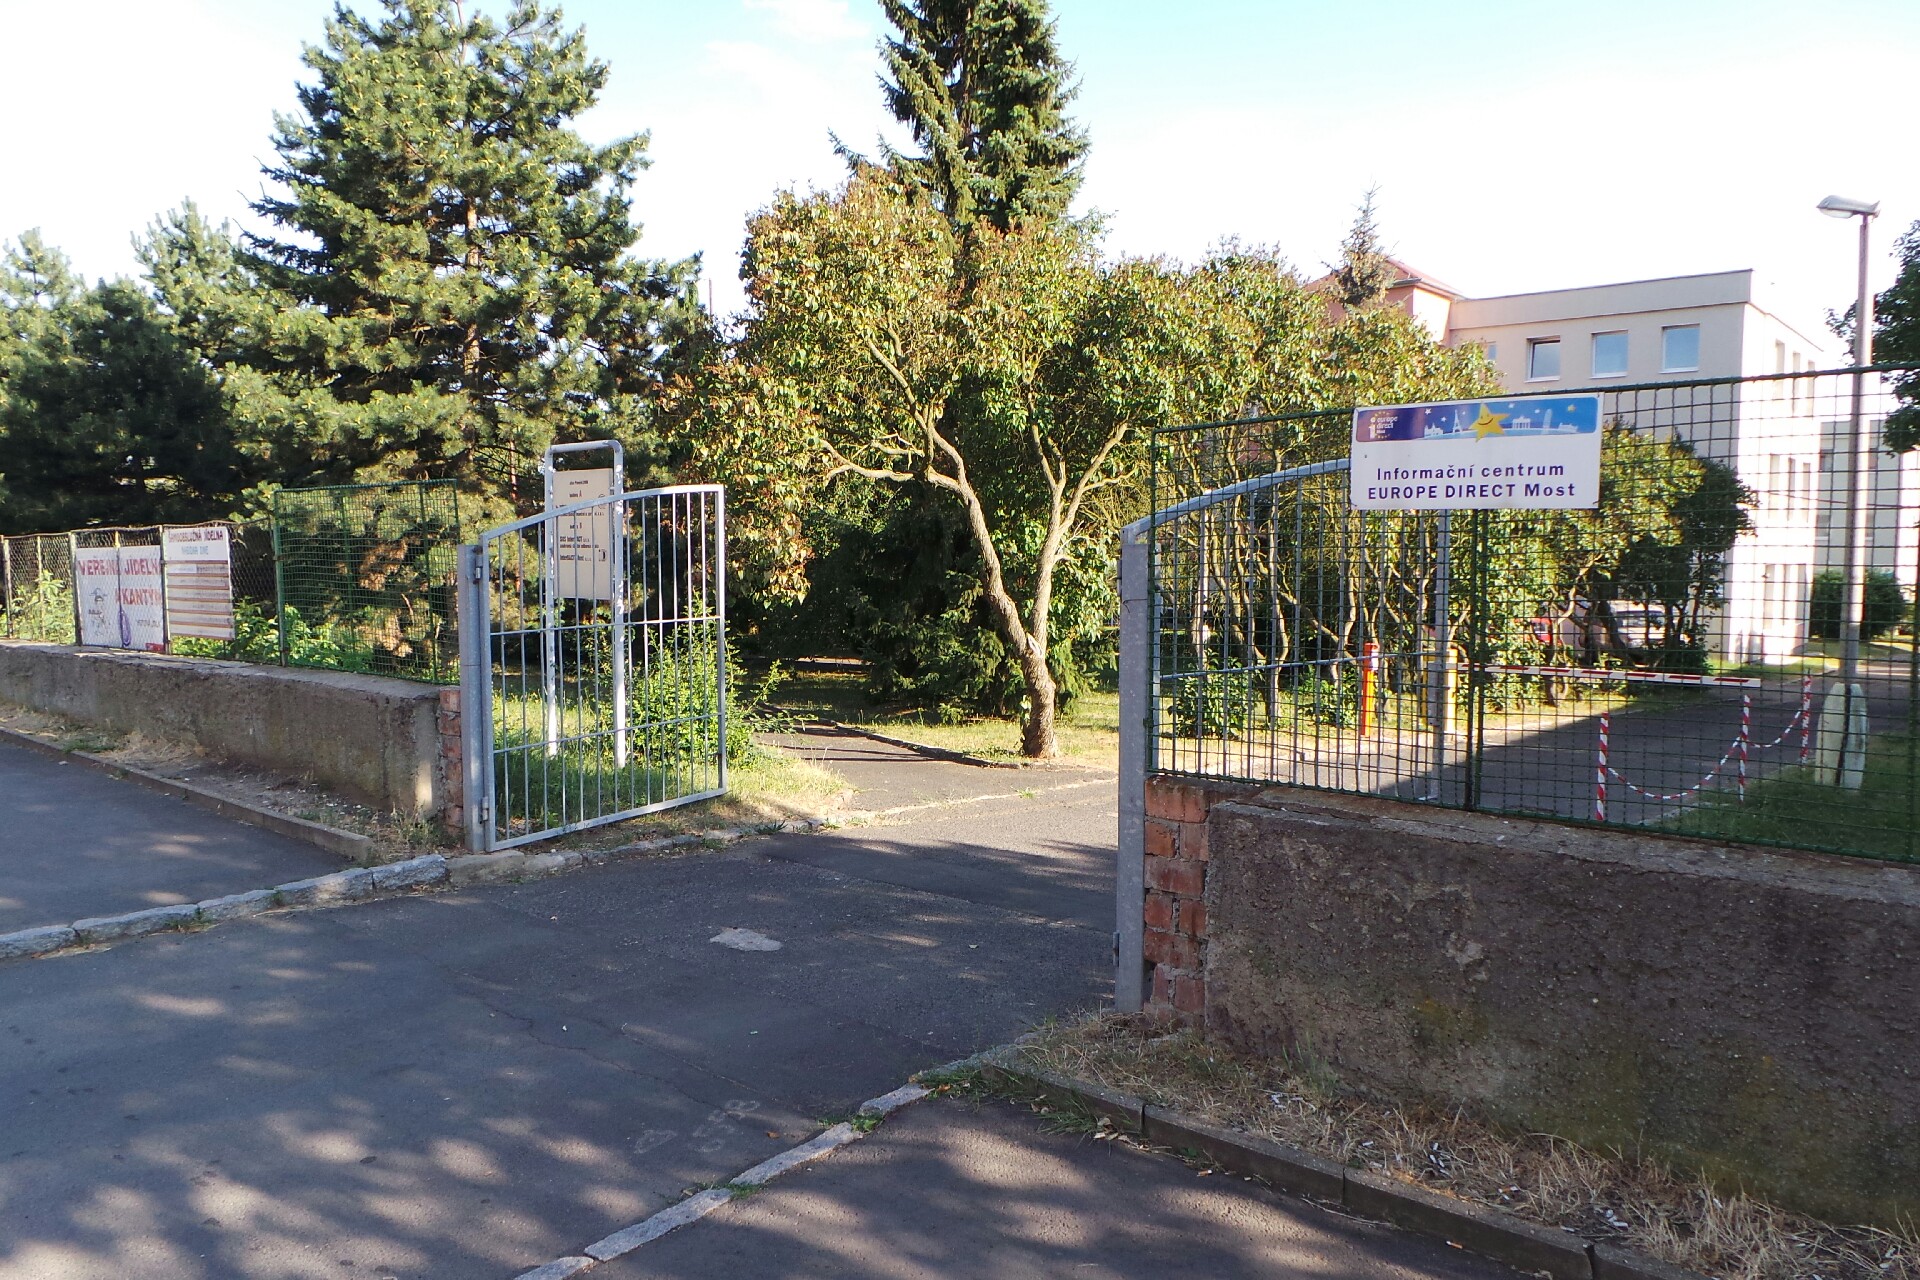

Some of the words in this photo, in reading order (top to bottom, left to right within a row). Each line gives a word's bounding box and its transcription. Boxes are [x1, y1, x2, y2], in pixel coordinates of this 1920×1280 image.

[1376, 416, 1398, 424] europe
[1377, 464, 1475, 481] Informační
[1481, 463, 1564, 477] centrum
[1368, 485, 1438, 500] EUROPE
[1445, 483, 1516, 498] DIRECT
[1524, 482, 1576, 497] Most
